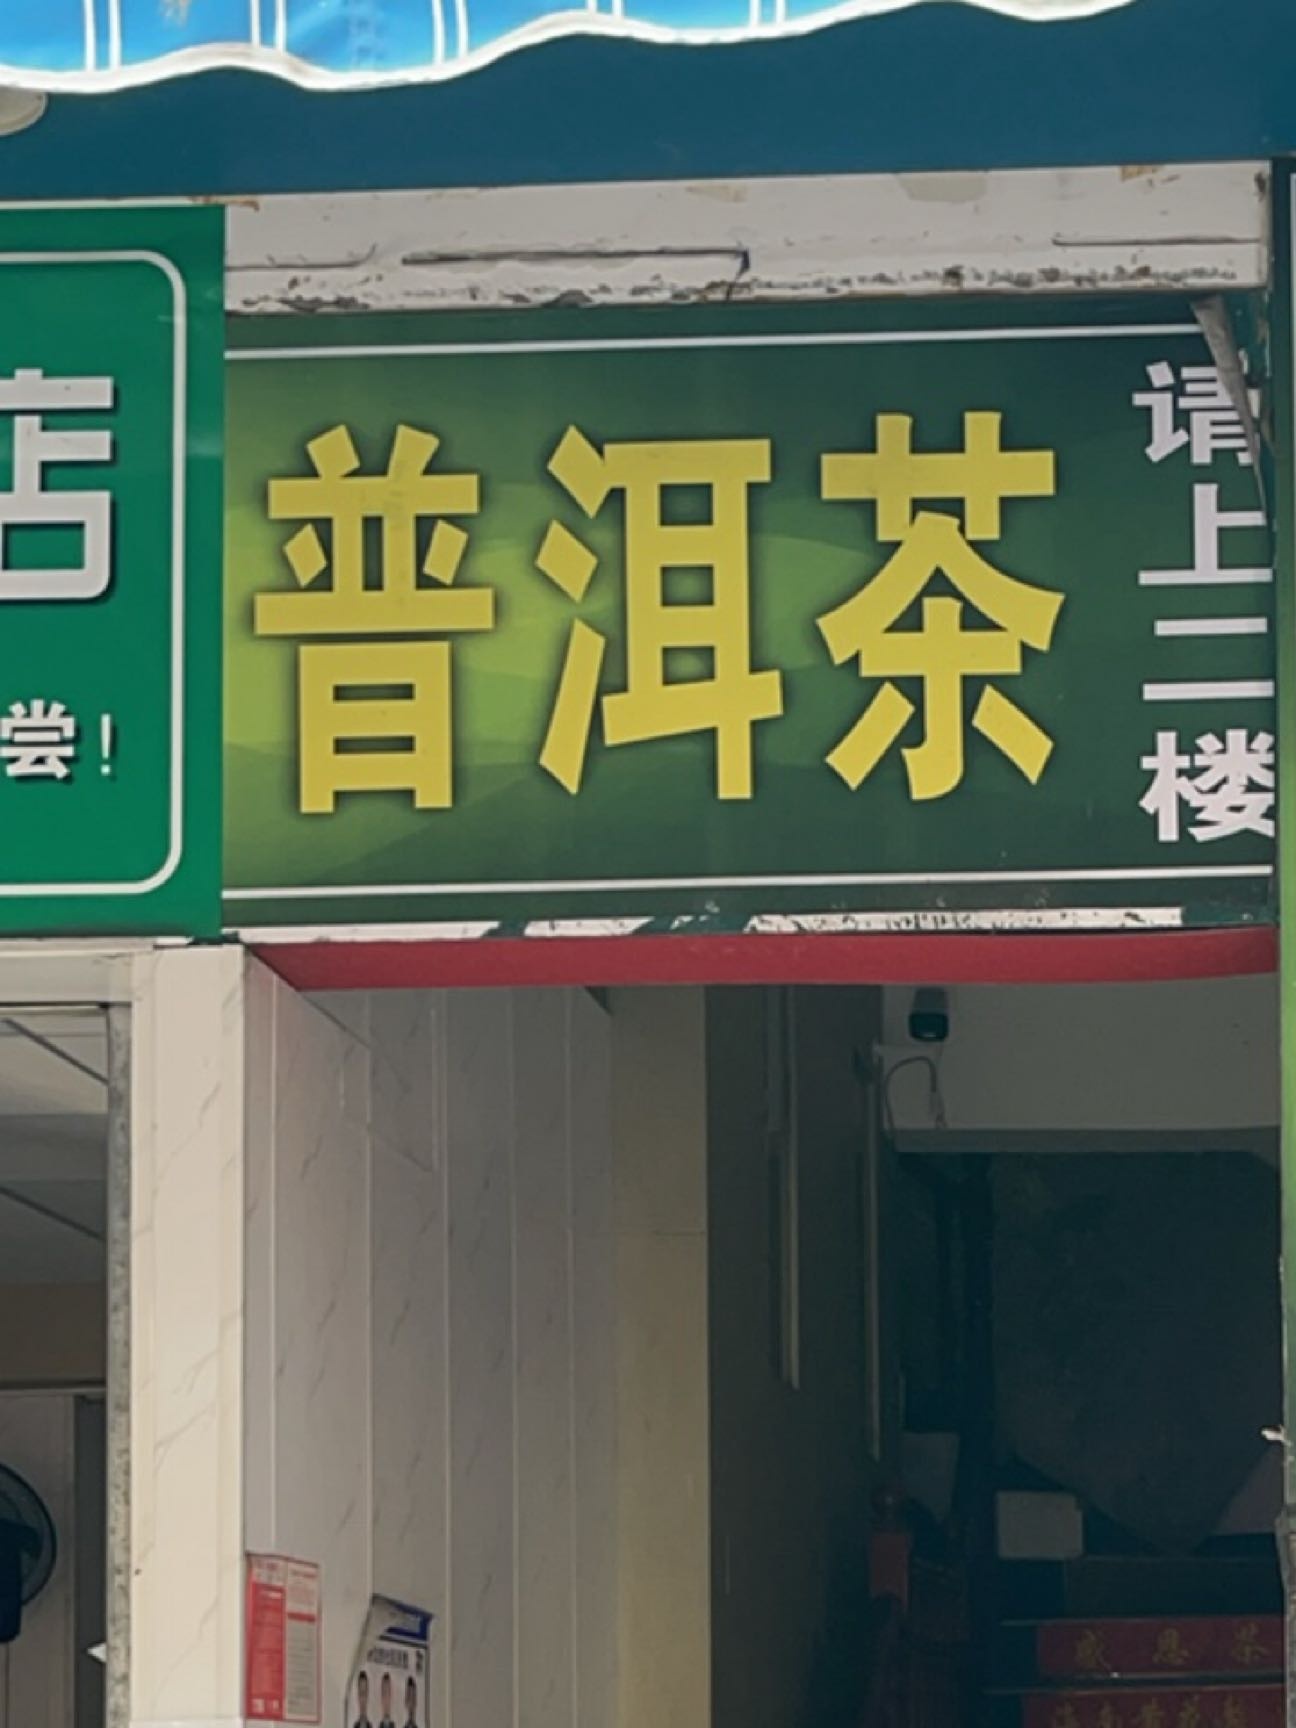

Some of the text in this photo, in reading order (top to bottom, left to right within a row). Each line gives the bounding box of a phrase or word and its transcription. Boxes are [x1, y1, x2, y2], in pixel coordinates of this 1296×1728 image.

[0, 368, 114, 600] 店
[253, 410, 1066, 815] 普洱茶
[1131, 349, 1276, 843] 请上二楼
